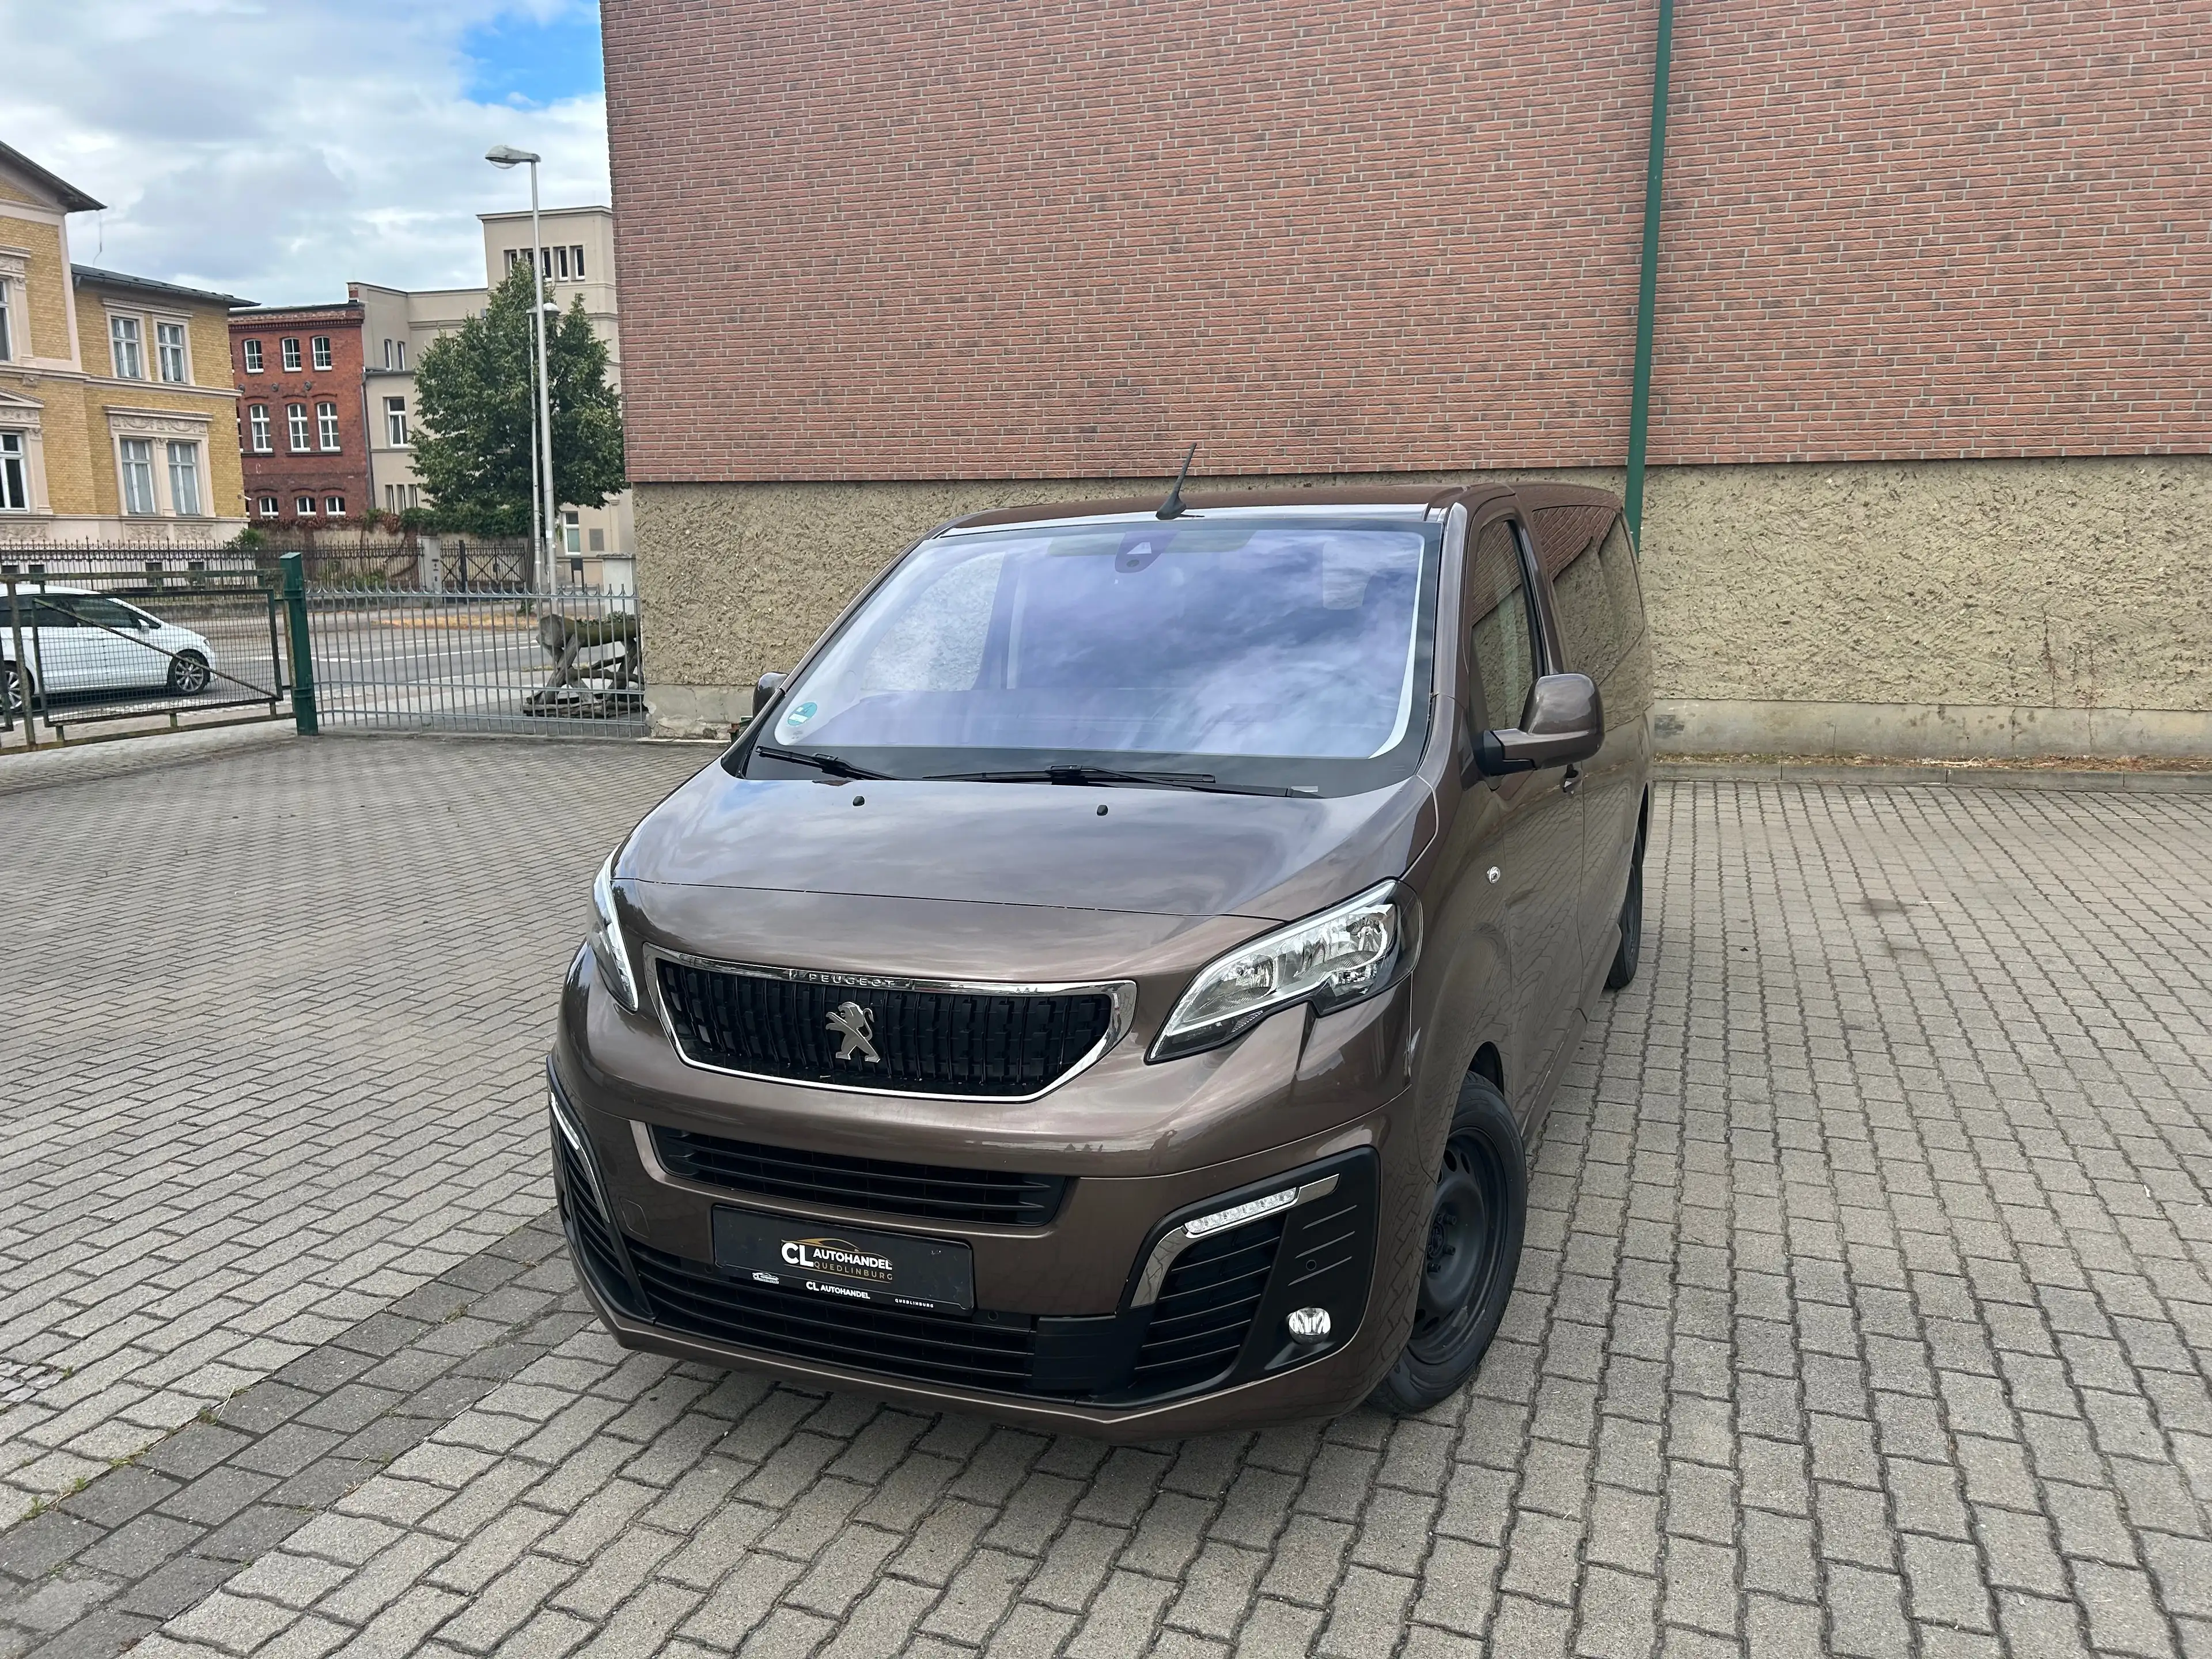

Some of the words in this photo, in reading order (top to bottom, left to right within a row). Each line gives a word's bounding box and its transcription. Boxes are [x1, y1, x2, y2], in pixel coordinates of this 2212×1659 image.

[808, 973, 895, 987] PEUGEOT
[781, 1243, 814, 1267] CL
[813, 1248, 893, 1270] AUTOHANDEL
[814, 1261, 893, 1281] QUEDLINBURG
[806, 1281, 820, 1291] CL
[820, 1285, 871, 1300] AUTOHANDEL
[895, 1298, 934, 1308] QUEDLINBURG
